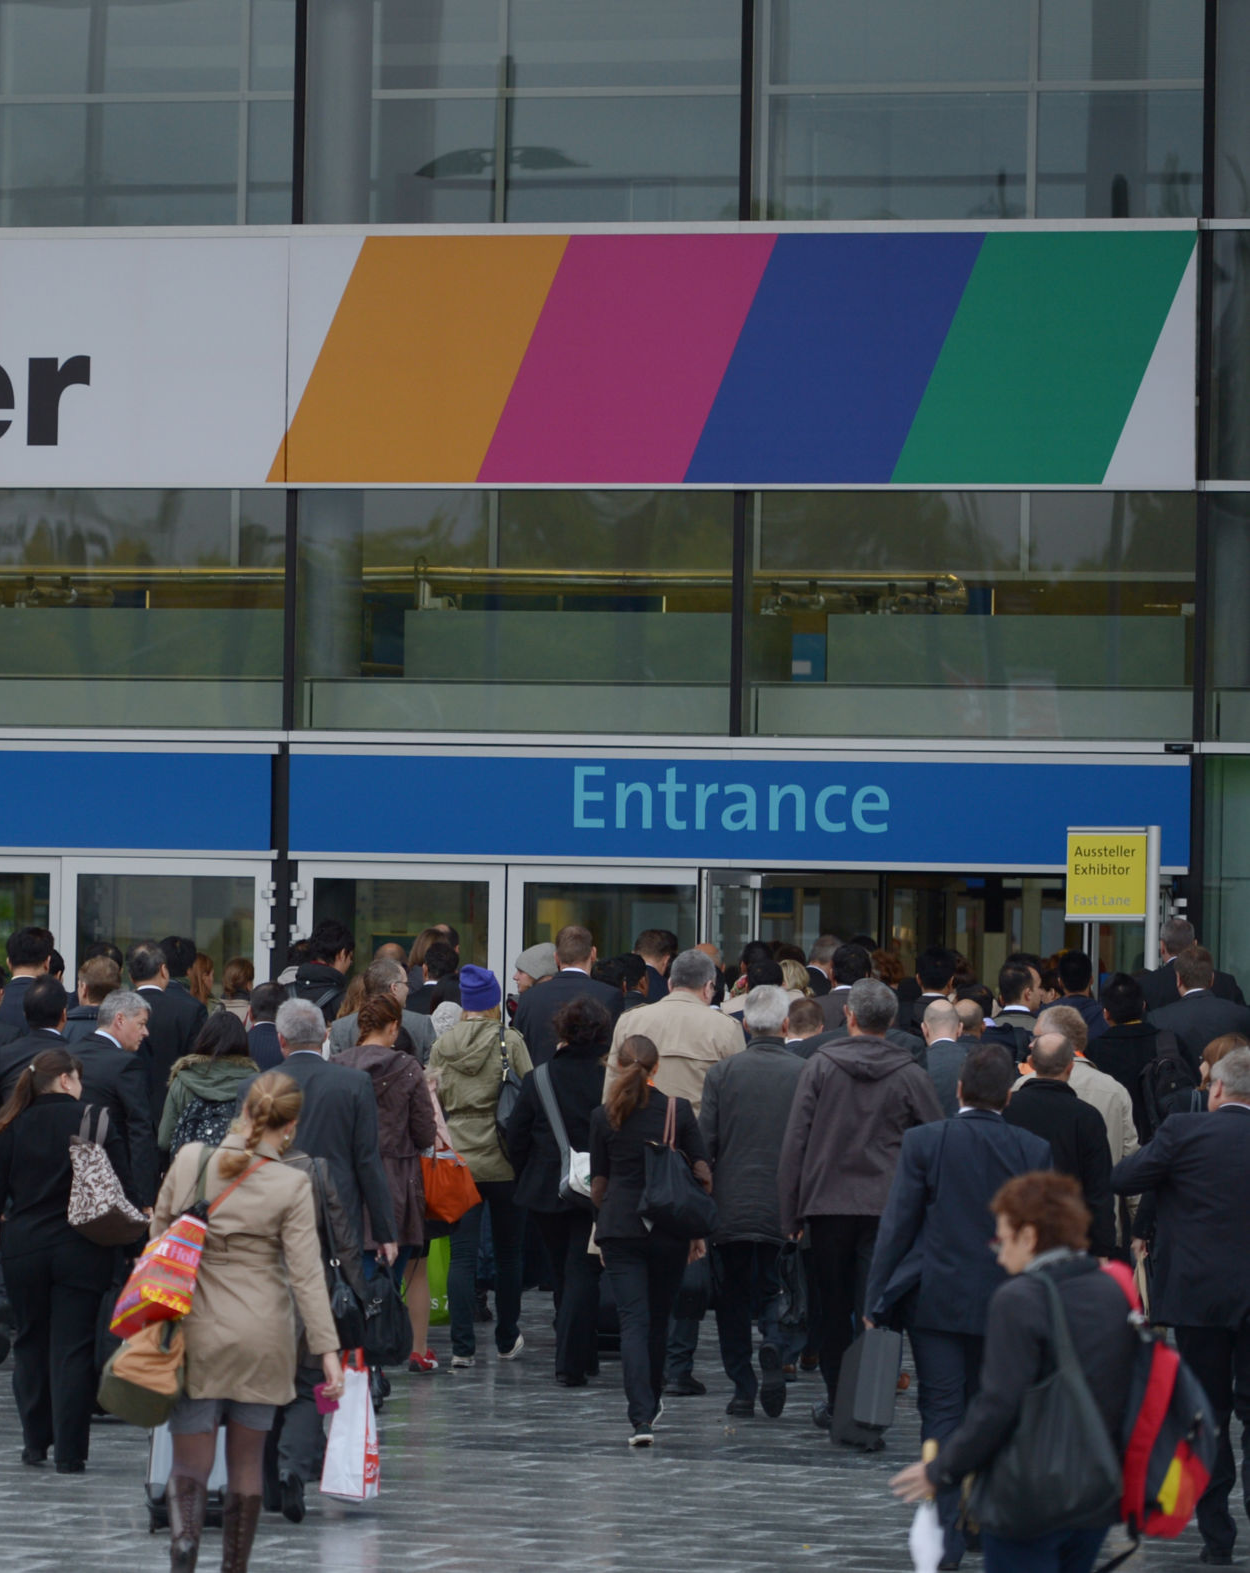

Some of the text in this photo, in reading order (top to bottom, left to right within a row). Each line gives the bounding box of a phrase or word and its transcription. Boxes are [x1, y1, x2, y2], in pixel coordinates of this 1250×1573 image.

[573, 765, 890, 834] Entrance
[1074, 845, 1136, 857] Aussteller
[1074, 863, 1130, 875] Exhibitor
[1073, 894, 1131, 906] Fast Lane
